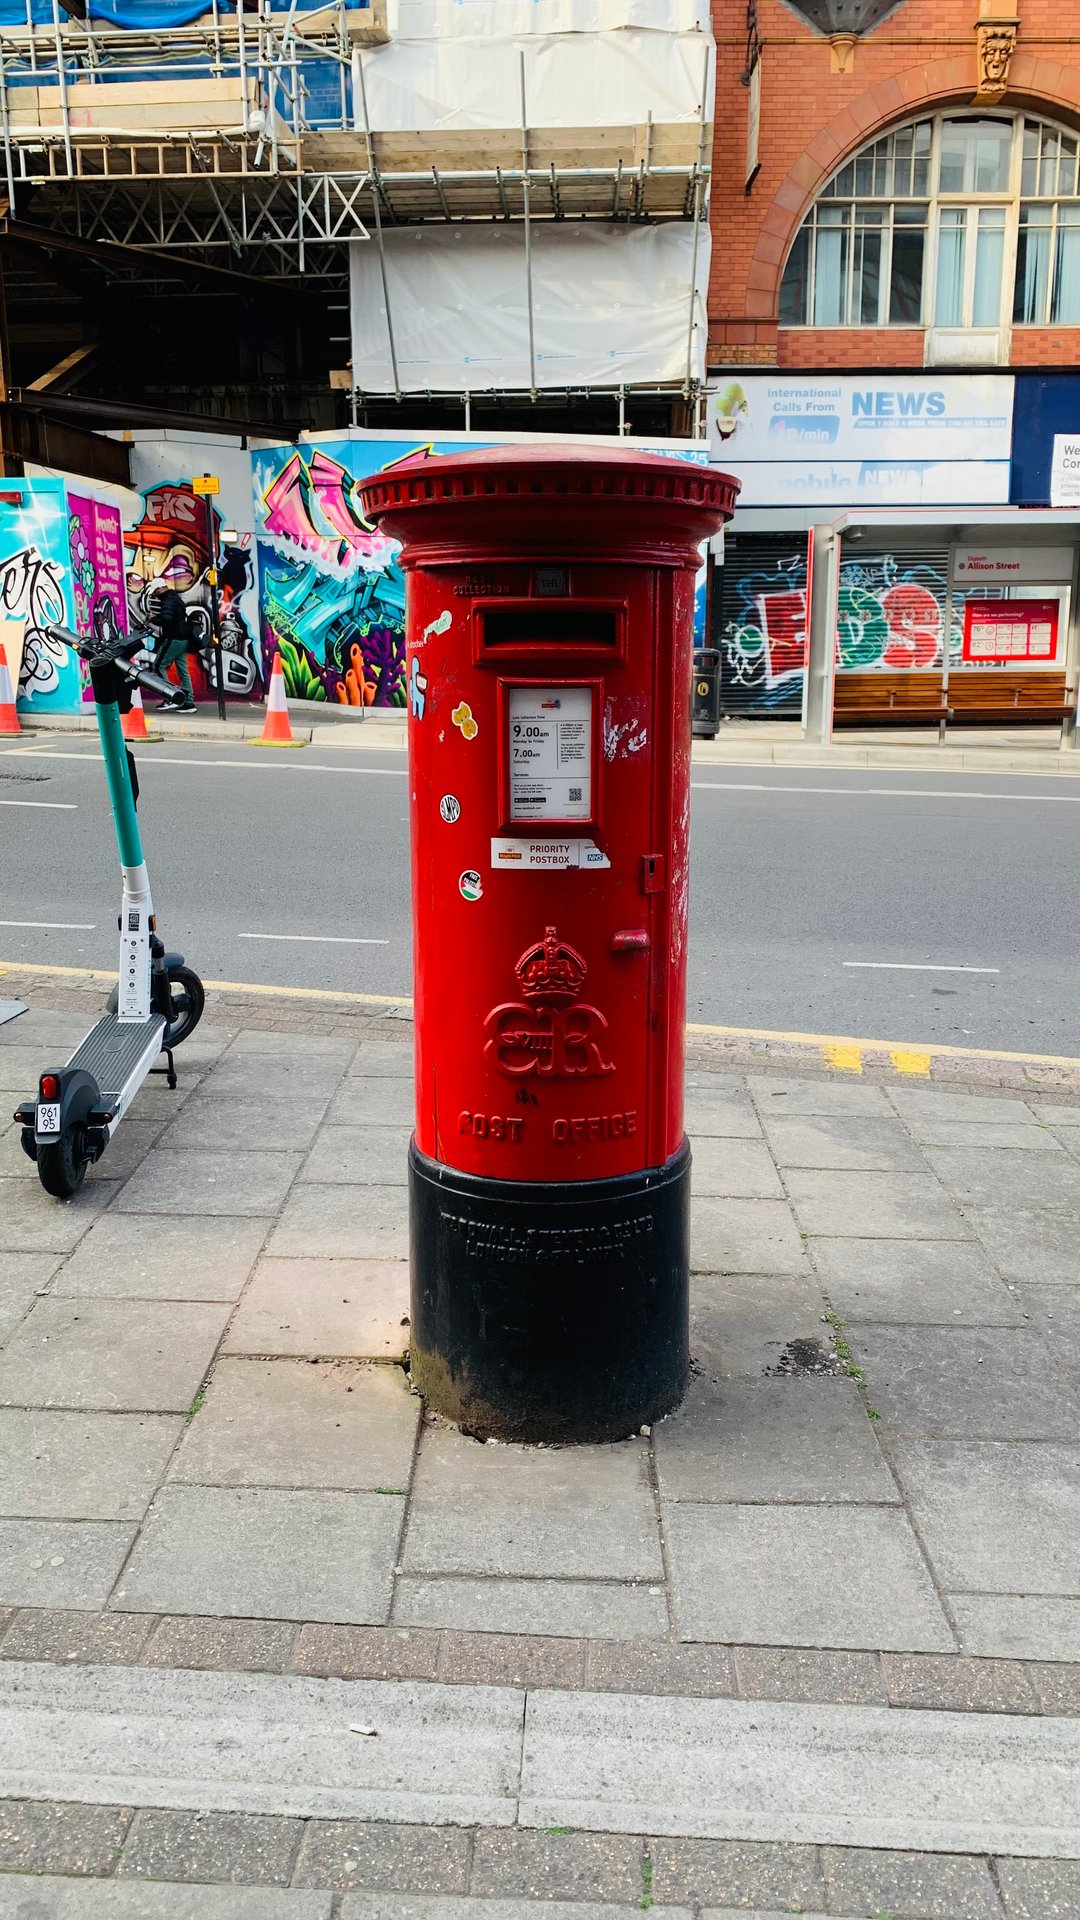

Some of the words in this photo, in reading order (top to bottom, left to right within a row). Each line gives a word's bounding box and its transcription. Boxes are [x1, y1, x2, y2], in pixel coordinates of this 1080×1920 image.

[767, 388, 842, 398] International
[773, 402, 802, 412] Calls
[805, 402, 835, 412] From
[852, 391, 946, 416] NEWS
[146, 493, 197, 522] FKS
[968, 562, 994, 570] Allison
[996, 562, 1020, 570] Street
[541, 578, 562, 588] THU
[453, 584, 511, 595] COLLECTION
[513, 725, 549, 737] 9.00am
[513, 748, 541, 757] 7.00am
[530, 845, 570, 853] PRIORITY
[530, 856, 570, 864] POSTBOX
[40, 1107, 57, 1118] 961
[42, 1119, 55, 1129] 95
[458, 1110, 523, 1142] POST
[553, 1110, 637, 1140] OFFICE
